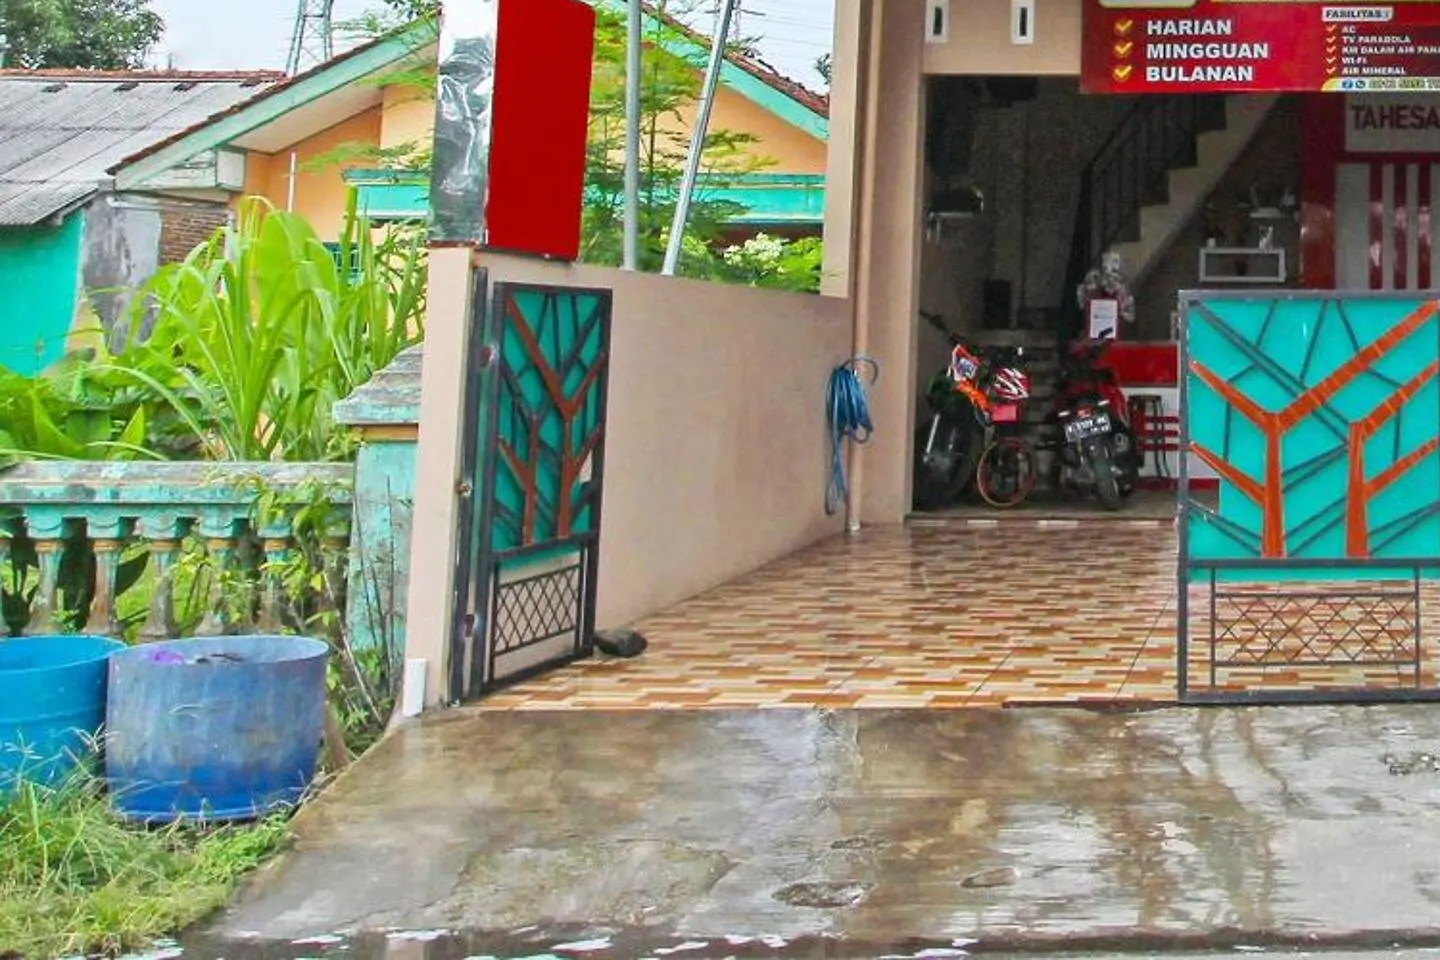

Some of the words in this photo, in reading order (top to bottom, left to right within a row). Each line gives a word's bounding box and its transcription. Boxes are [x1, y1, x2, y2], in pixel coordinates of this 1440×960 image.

[1147, 20, 1232, 36] HARIAN
[1146, 43, 1269, 58] MINGGUAN
[1146, 66, 1253, 82] BULANAN
[1362, 66, 1406, 75] MINERAL
